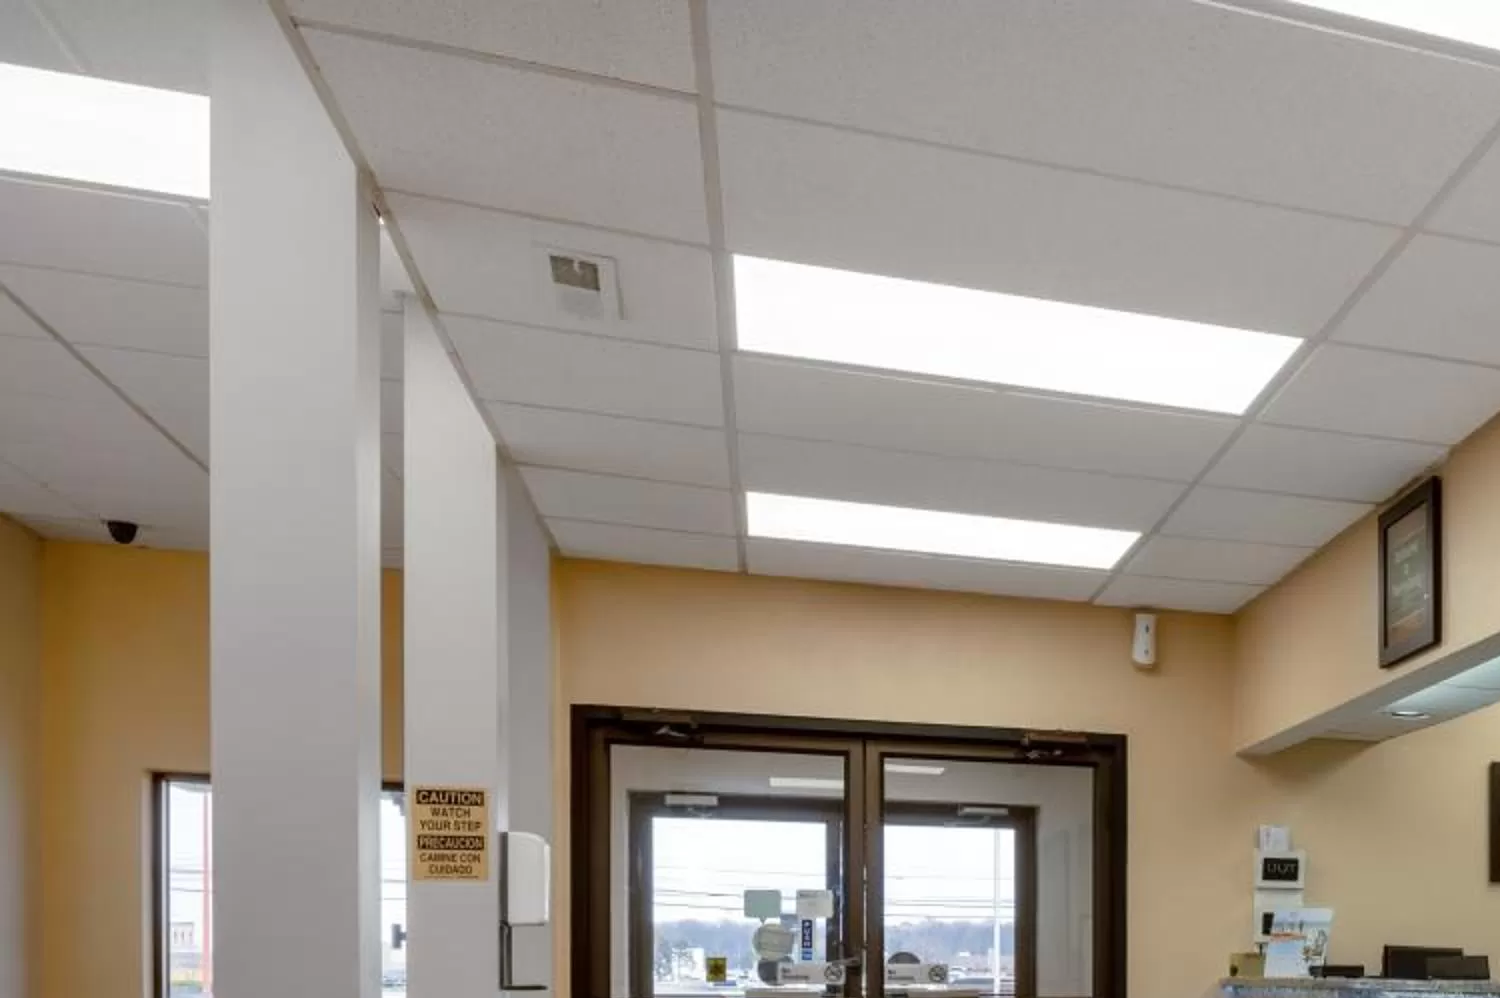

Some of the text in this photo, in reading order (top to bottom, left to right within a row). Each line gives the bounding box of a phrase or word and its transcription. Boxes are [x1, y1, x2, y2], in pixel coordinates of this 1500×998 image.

[420, 790, 481, 805] CAUTION
[431, 807, 471, 818] WATCH
[420, 820, 481, 832] YOUR STEP
[459, 853, 481, 863] CON
[428, 863, 473, 874] CUIDADO
